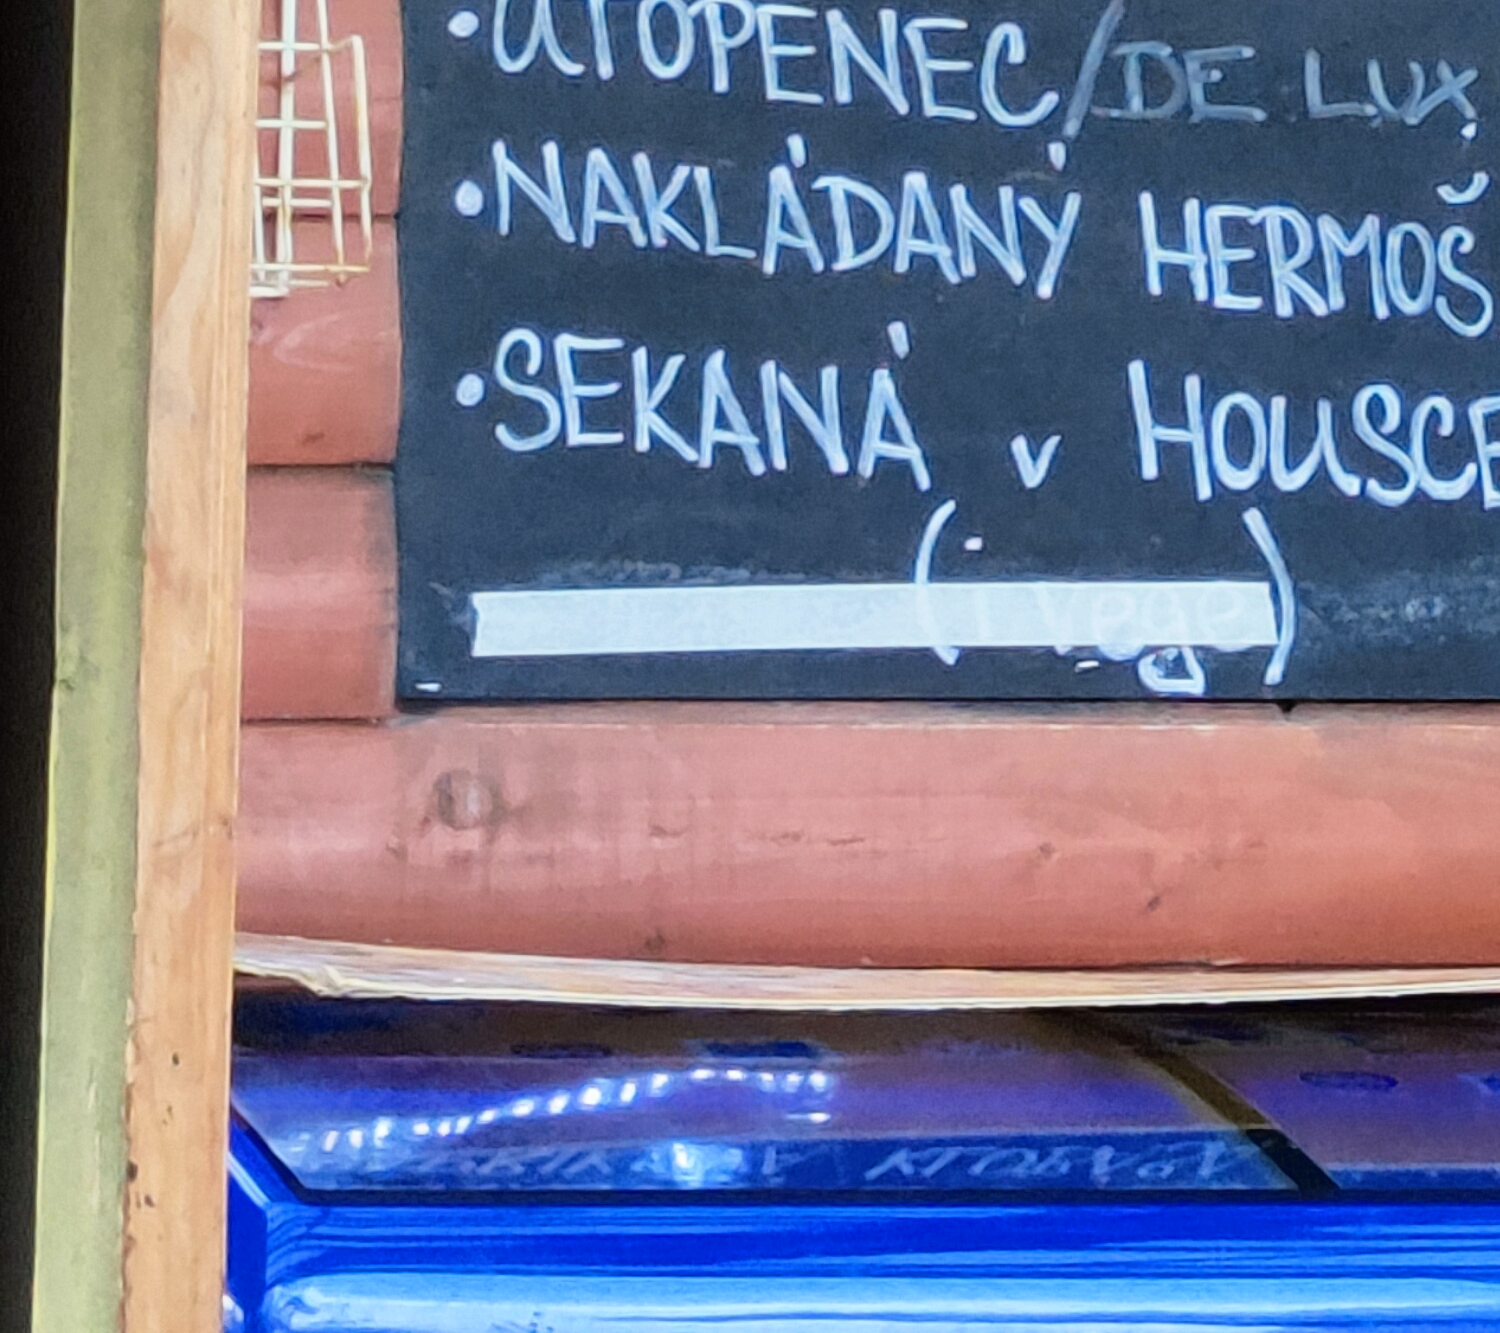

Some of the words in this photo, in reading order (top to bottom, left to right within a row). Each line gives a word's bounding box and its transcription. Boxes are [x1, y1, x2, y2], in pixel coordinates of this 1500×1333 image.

[491, 133, 1082, 300] NAKLÁDANÝ
[1138, 171, 1494, 338] HERMOŠ
[493, 320, 930, 492] SEKANÁ
